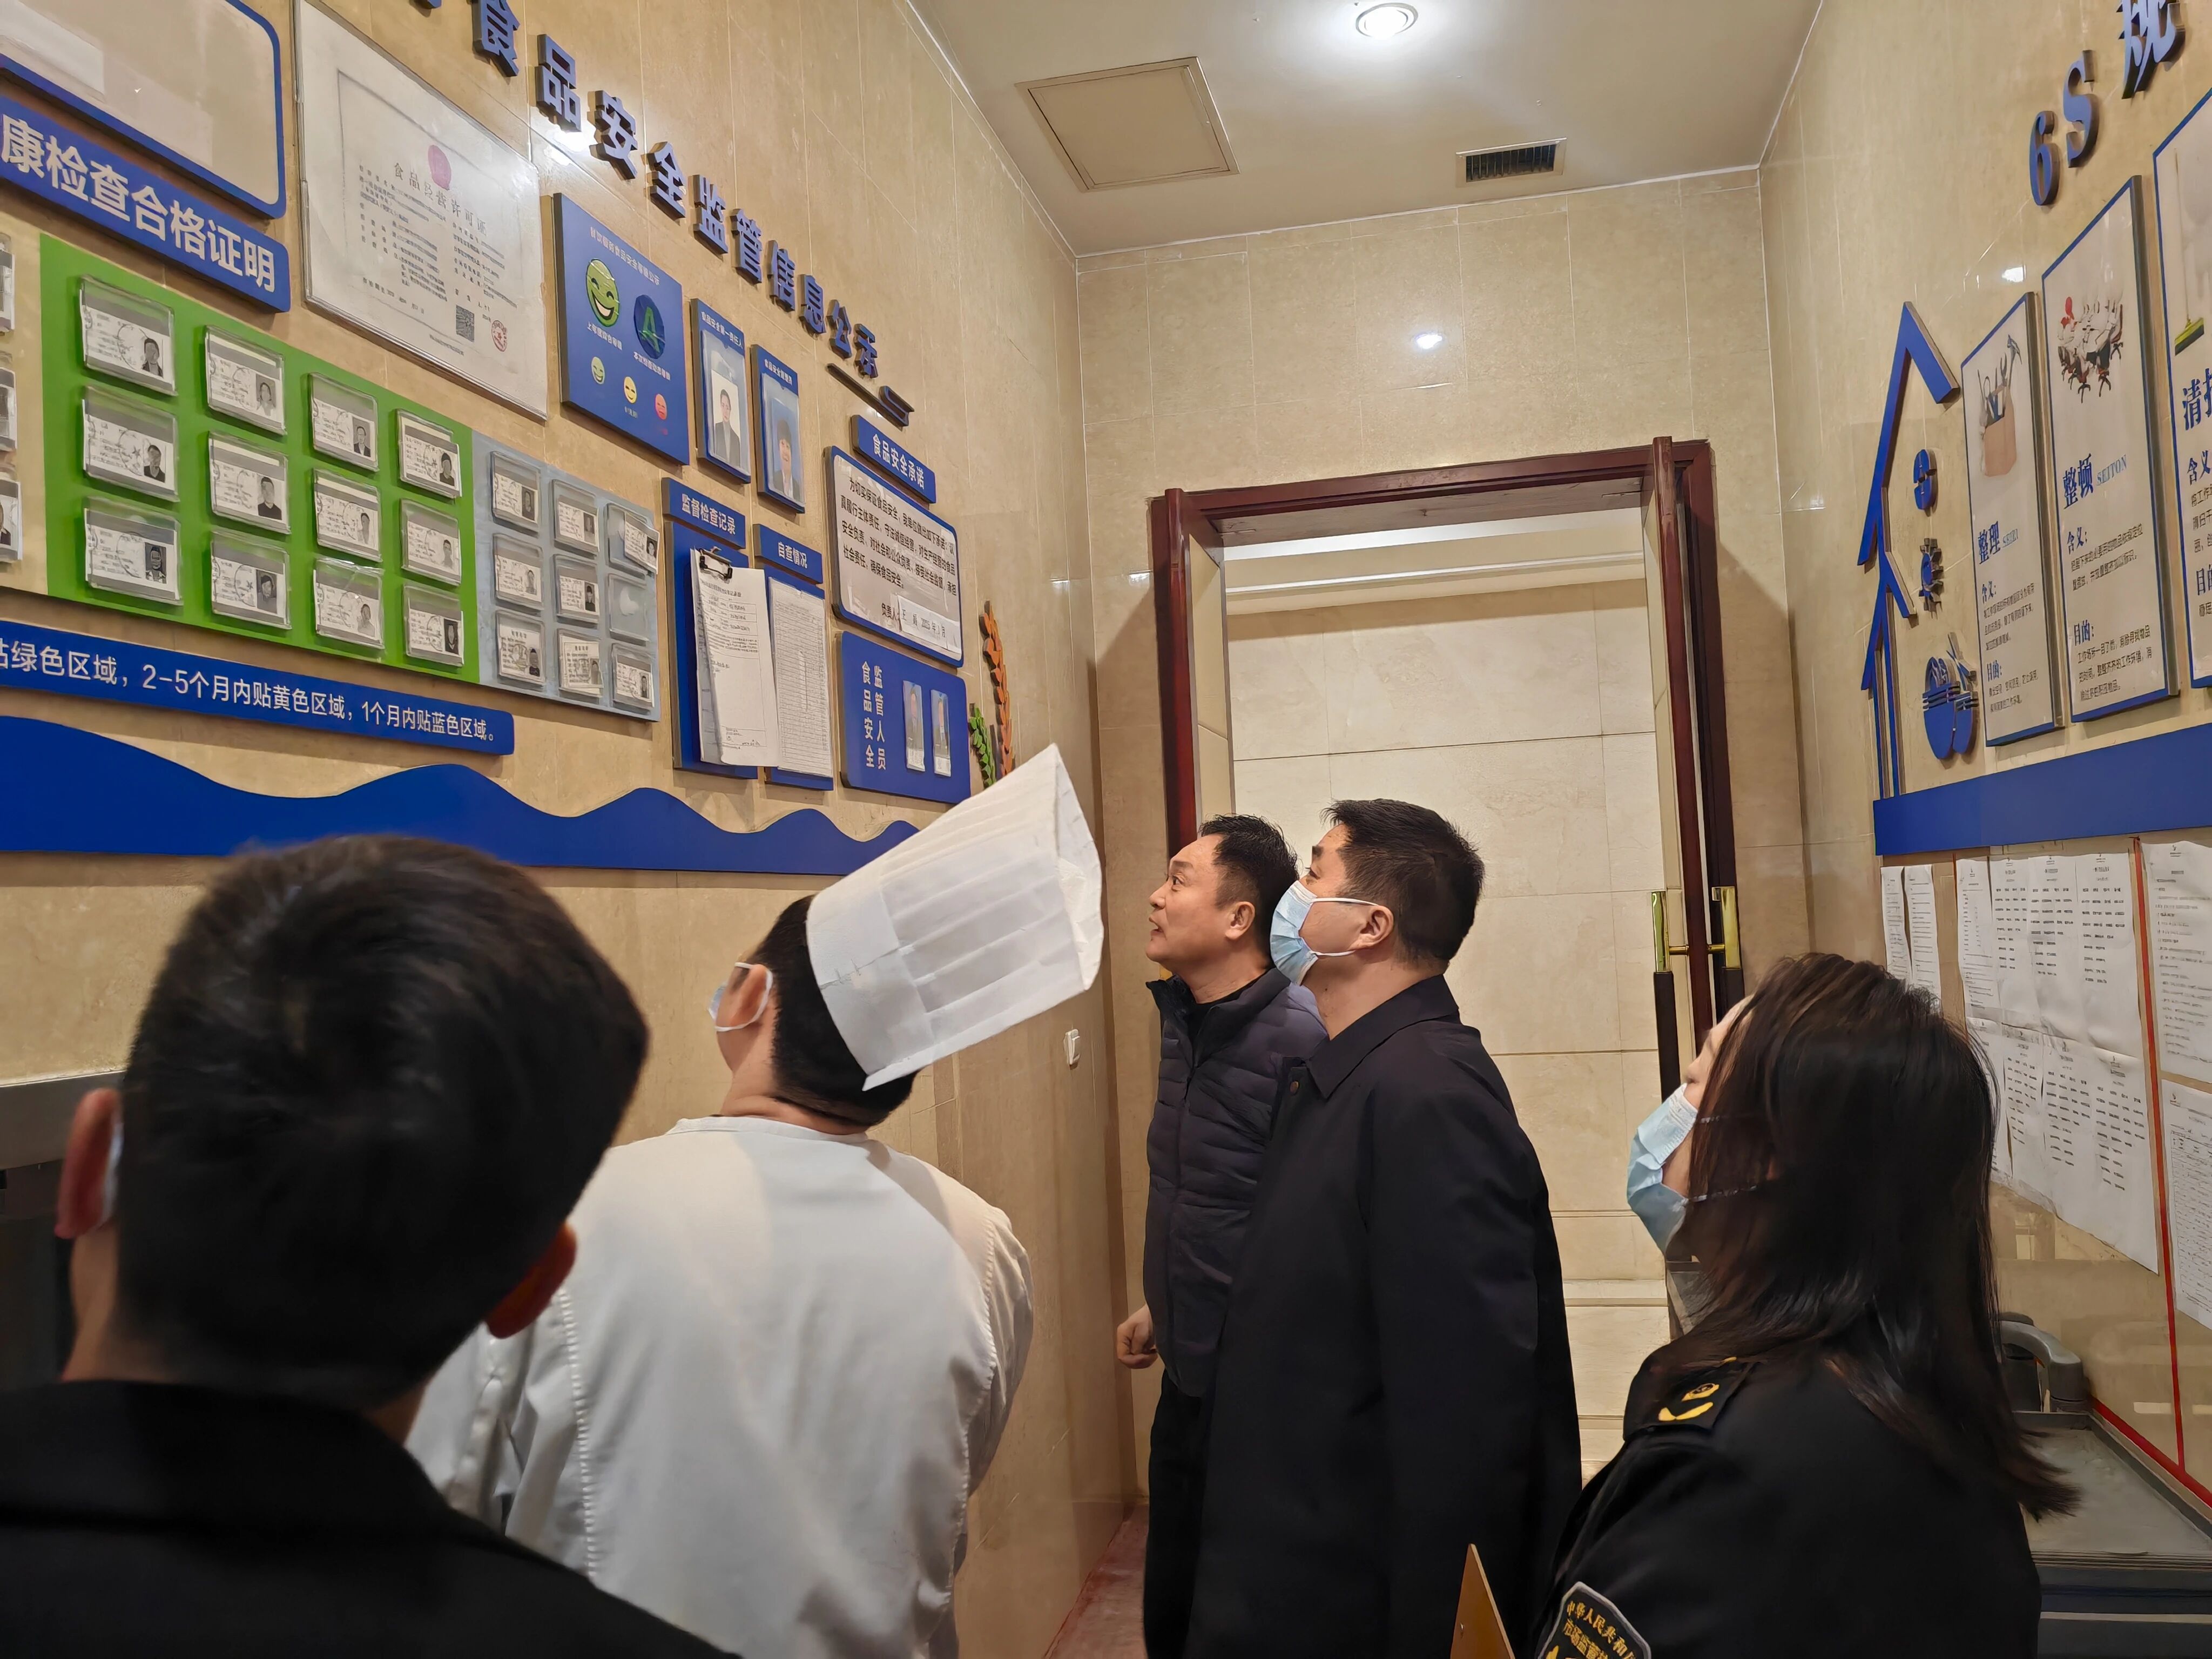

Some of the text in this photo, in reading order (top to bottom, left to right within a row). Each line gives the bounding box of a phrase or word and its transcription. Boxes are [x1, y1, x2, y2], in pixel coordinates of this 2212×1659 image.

[1, 114, 276, 292] 康检查合格证明
[394, 163, 487, 236] 食品经营许可证
[409, 0, 878, 379] 食品安全监管信息公示
[873, 433, 925, 490] 食品安全承诺
[2063, 453, 2094, 509] 整顿
[2096, 454, 2127, 486] SEITON
[682, 493, 736, 536] 监督检查记录
[778, 541, 807, 569] 自查情况
[1978, 521, 2001, 565] 整理
[2074, 619, 2094, 646] 目的：
[862, 660, 874, 768] 食品安全
[874, 665, 886, 770] 监管人员
